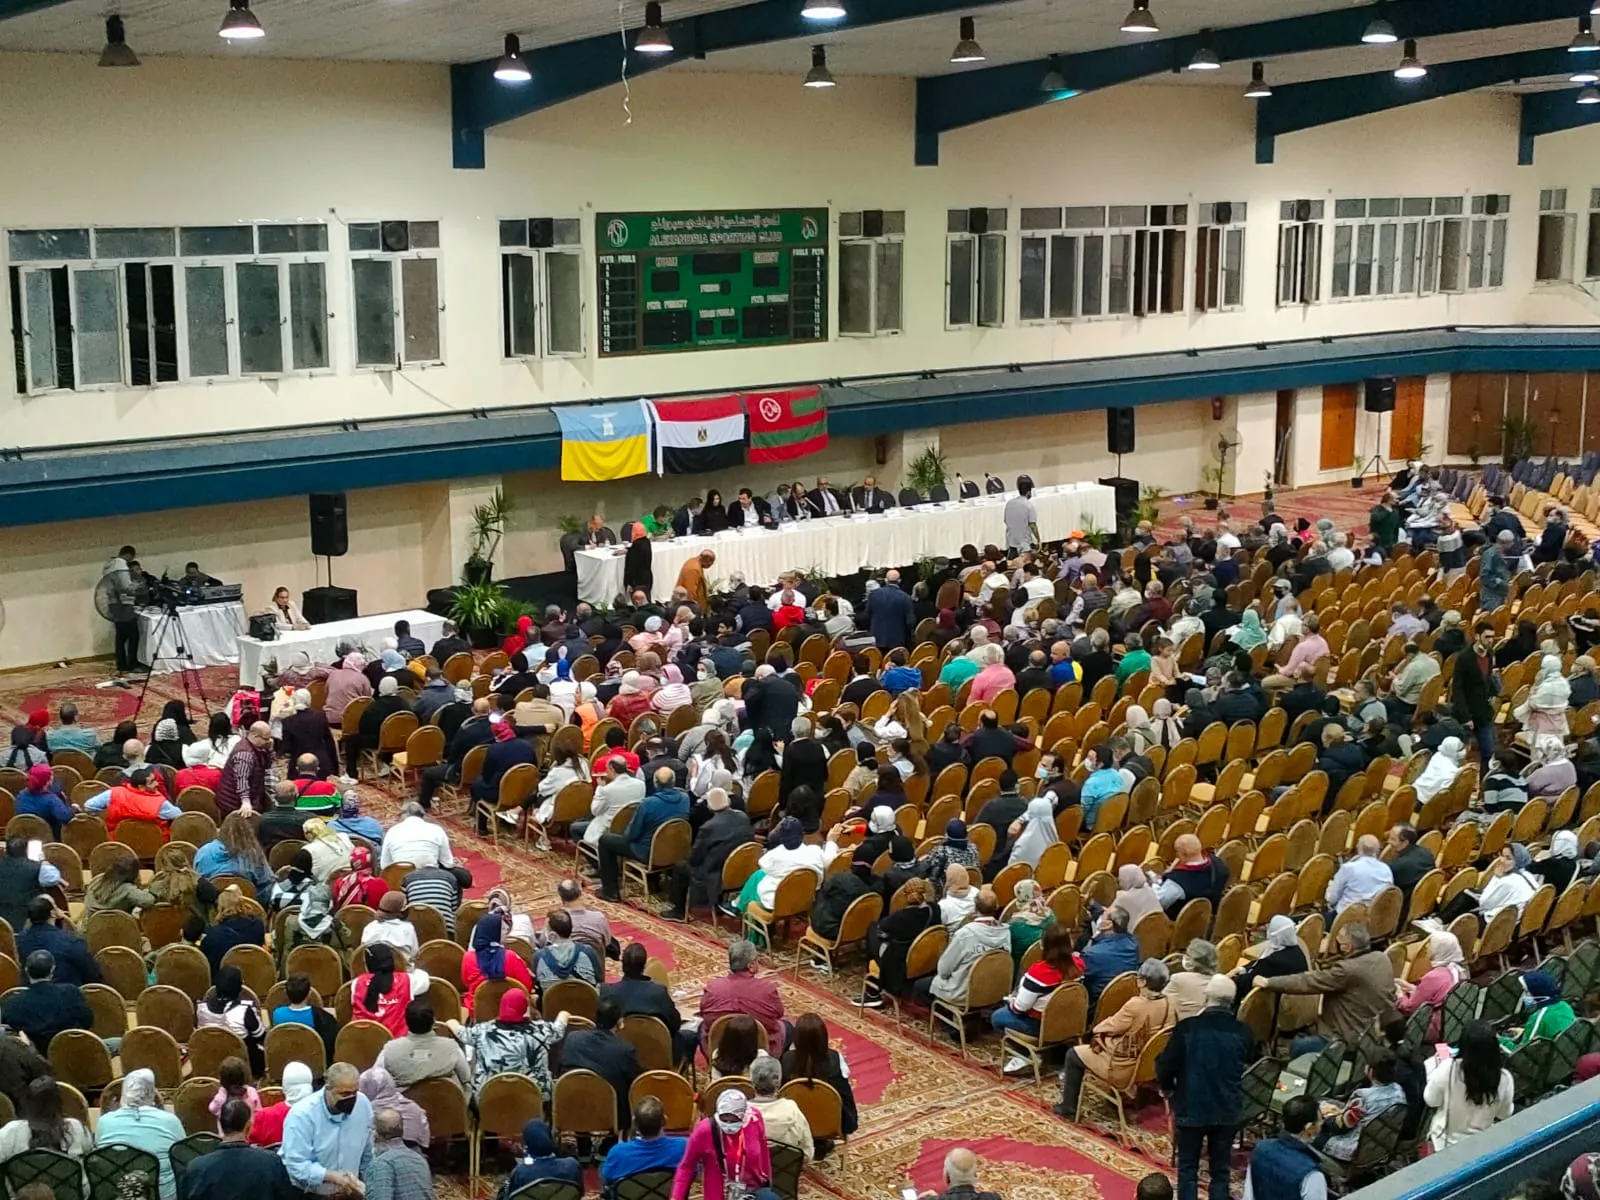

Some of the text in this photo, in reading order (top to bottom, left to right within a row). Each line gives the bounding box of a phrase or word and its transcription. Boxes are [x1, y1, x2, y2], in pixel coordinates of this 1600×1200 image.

[649, 231, 782, 247] ALEXANDRIA SPORTING CLUB
